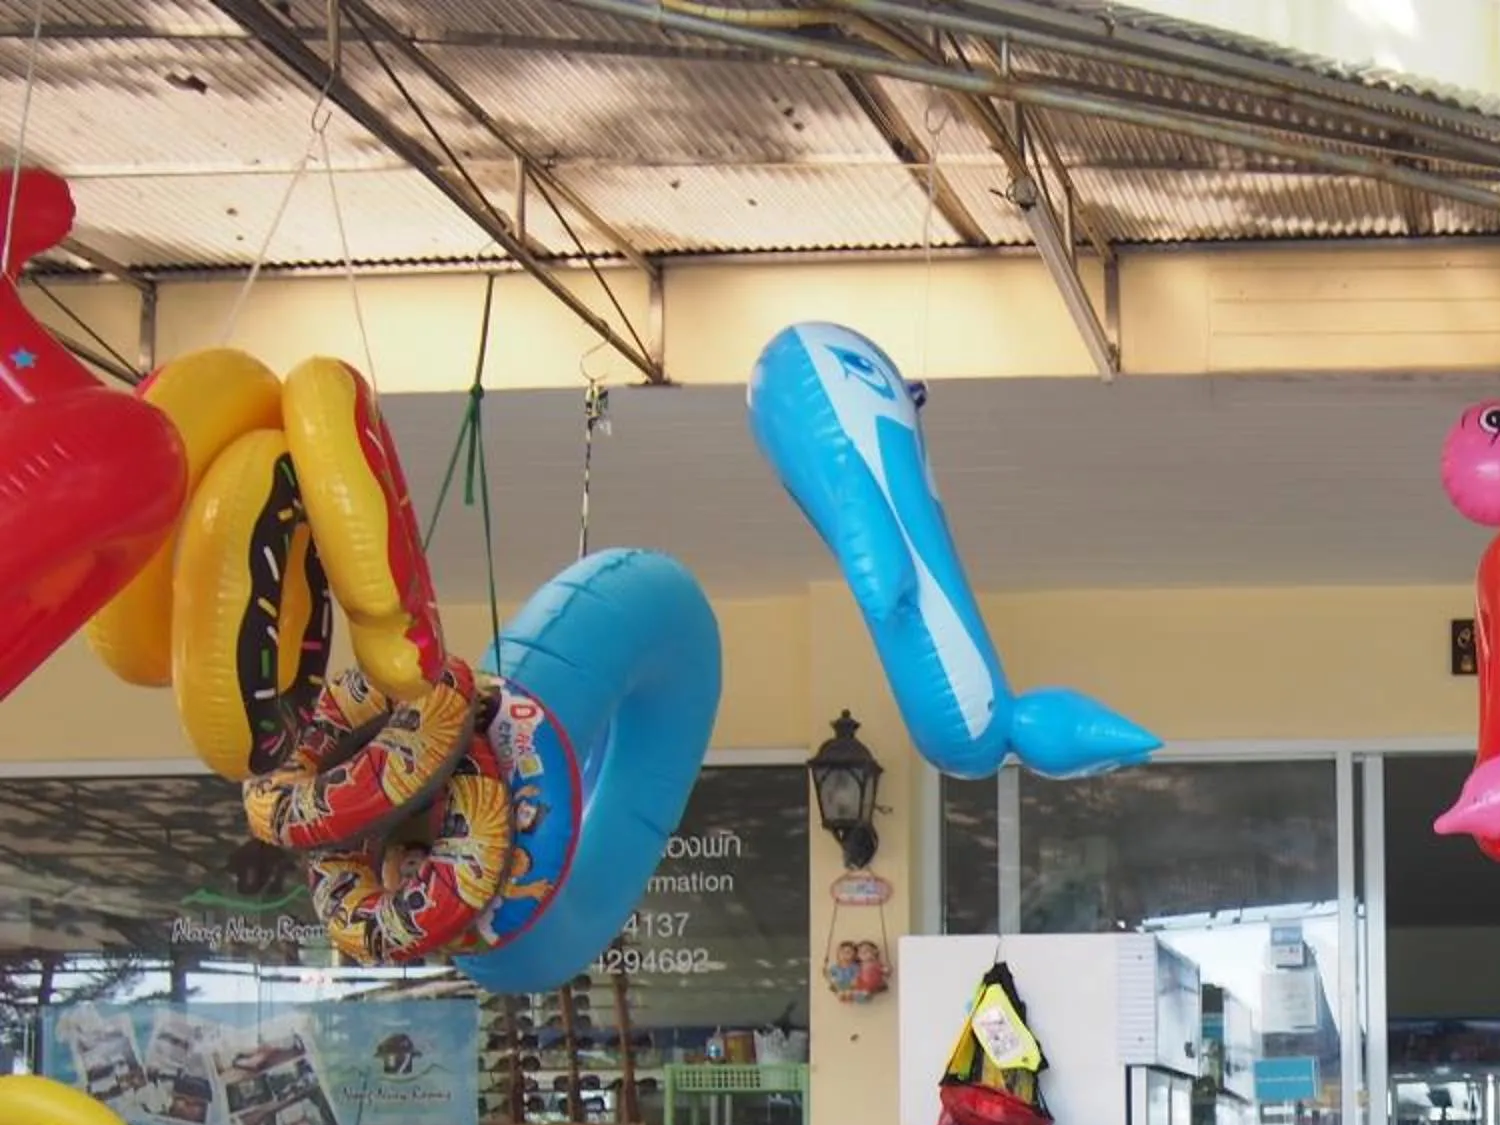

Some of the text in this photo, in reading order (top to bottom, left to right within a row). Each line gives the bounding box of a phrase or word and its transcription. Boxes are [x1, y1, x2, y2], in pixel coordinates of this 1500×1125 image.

[663, 829, 741, 858] องพัก
[647, 872, 733, 893] rmation
[276, 914, 327, 942] Room
